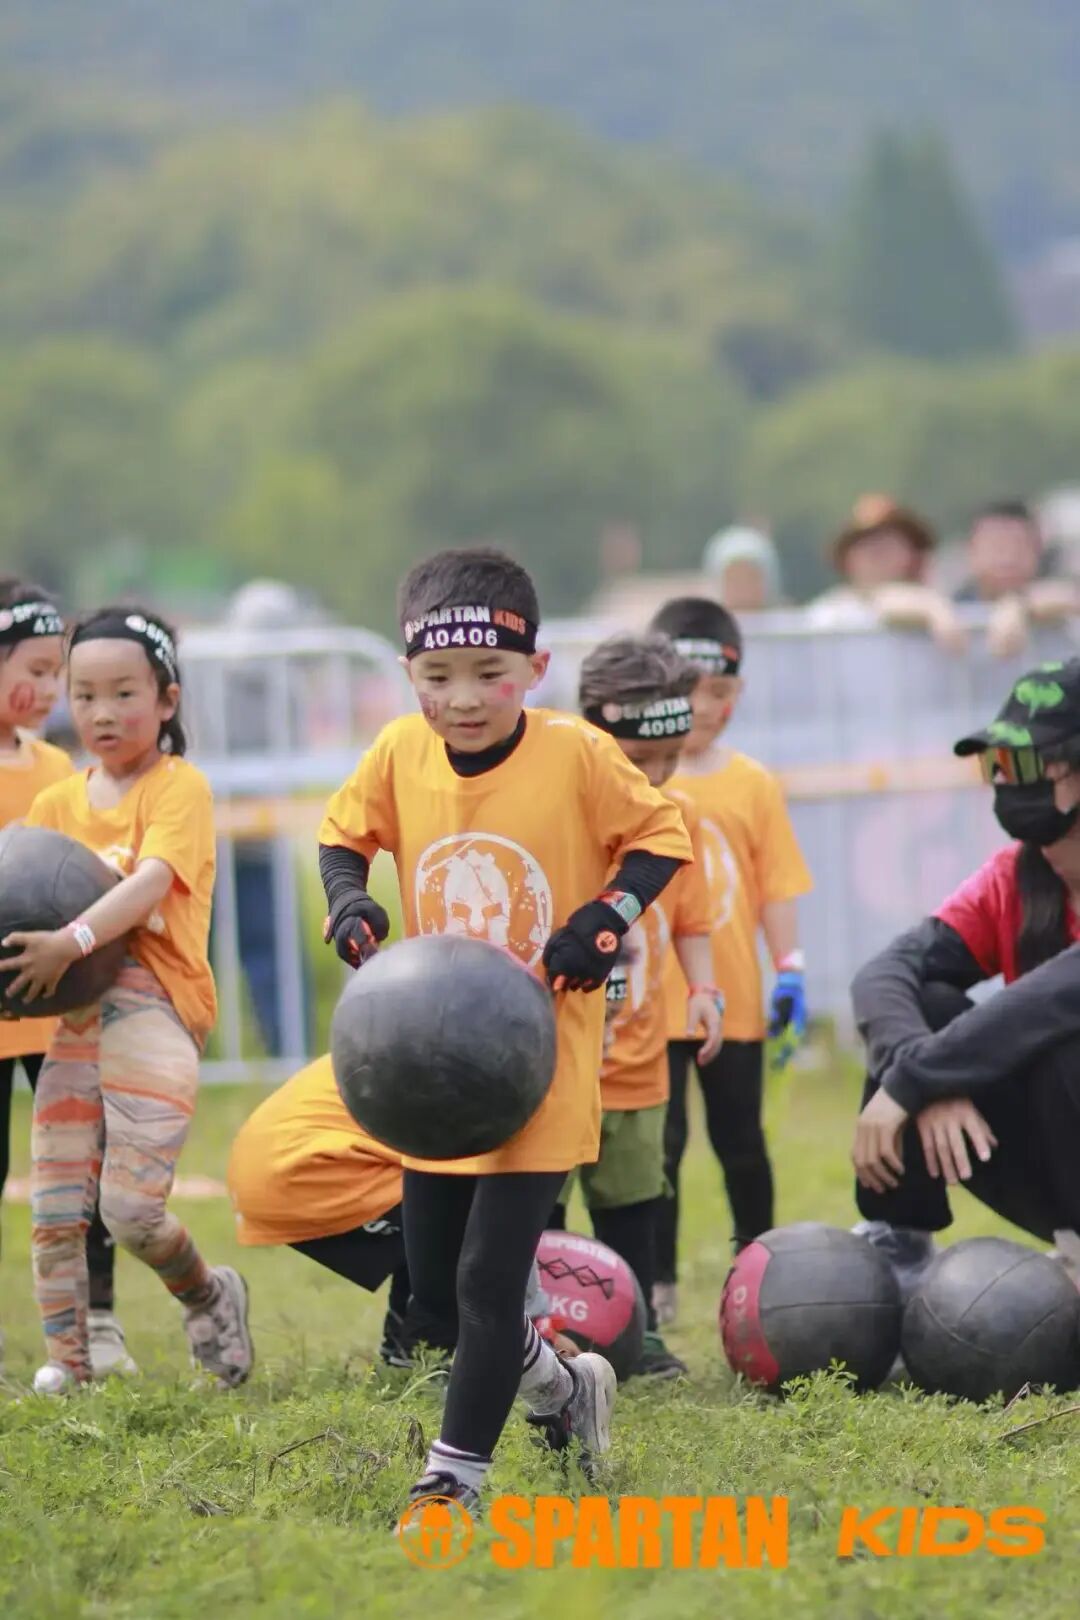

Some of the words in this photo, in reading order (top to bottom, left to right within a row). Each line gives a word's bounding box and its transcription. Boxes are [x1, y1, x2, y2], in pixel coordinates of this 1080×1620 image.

[413, 605, 491, 633] SPARTAN
[494, 609, 526, 635] KIDS
[424, 626, 498, 649] 40406
